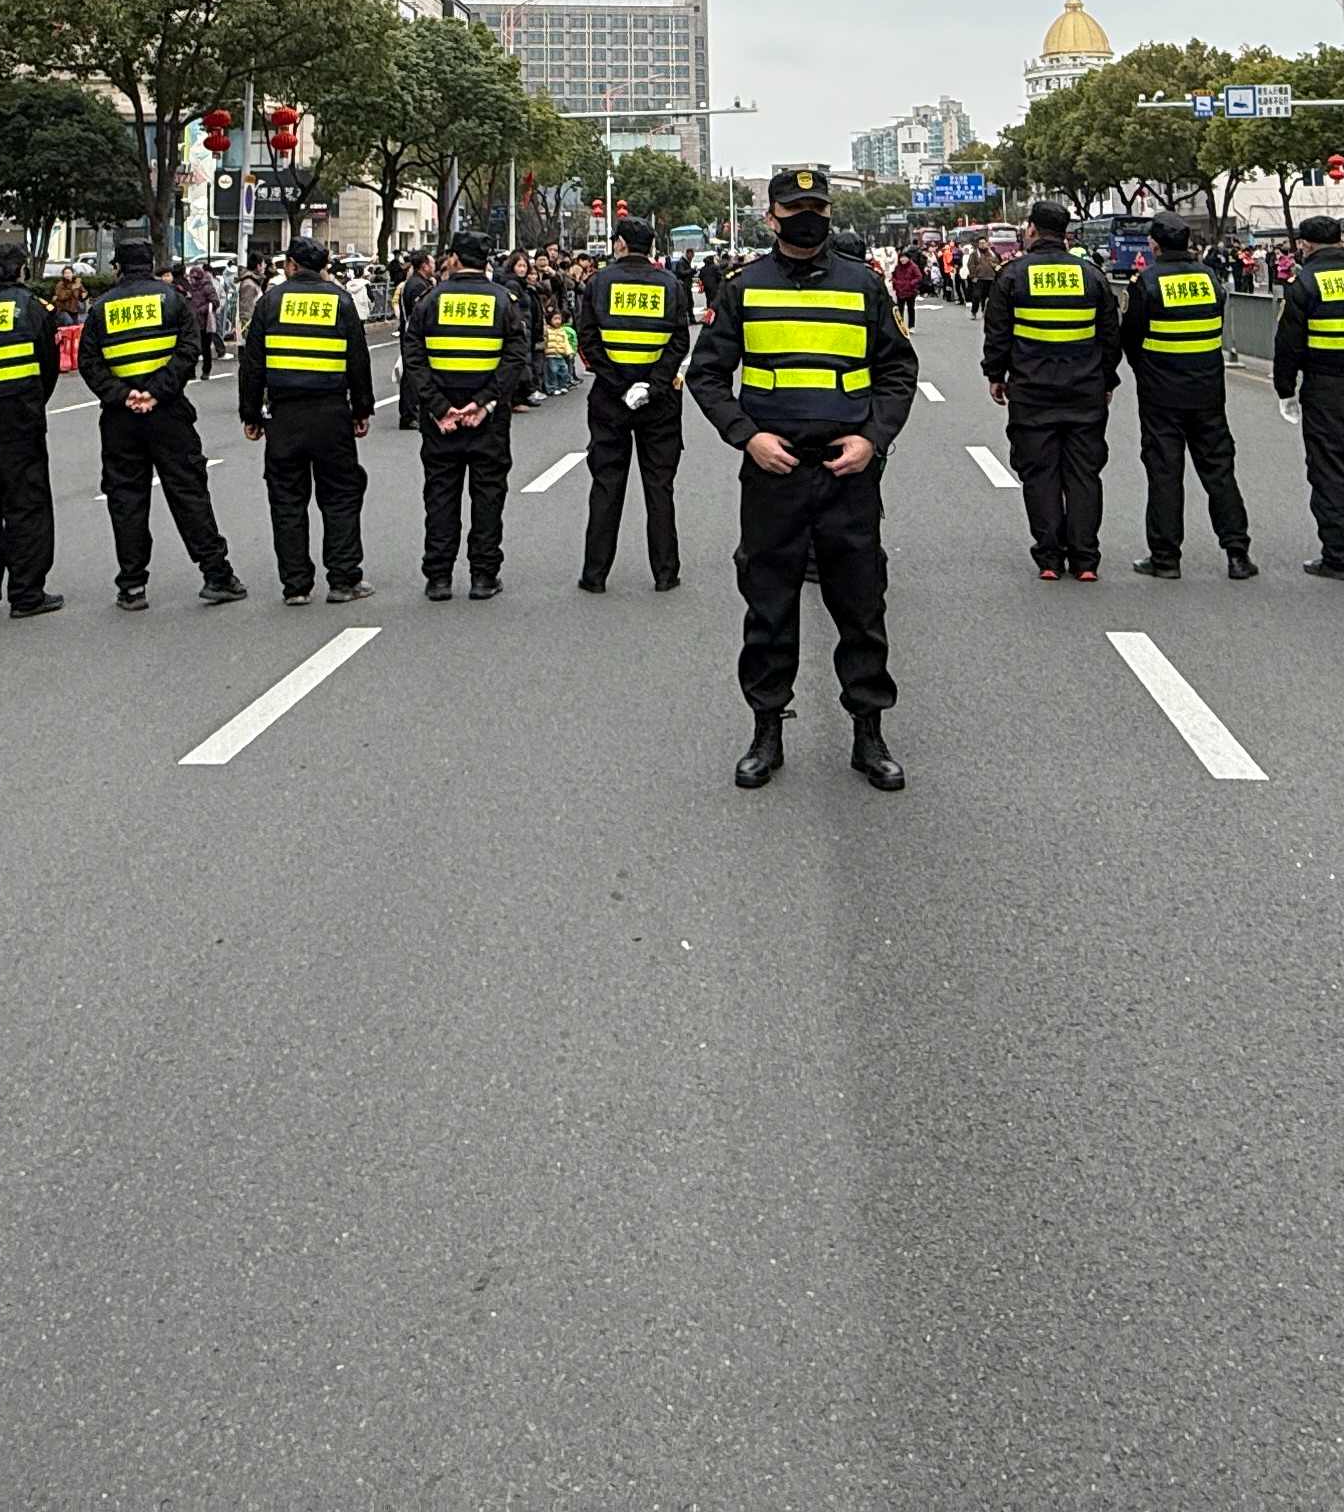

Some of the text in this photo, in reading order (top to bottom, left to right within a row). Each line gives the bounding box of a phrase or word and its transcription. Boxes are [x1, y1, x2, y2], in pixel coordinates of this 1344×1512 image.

[1034, 272, 1080, 289] 利邦保安
[1165, 282, 1211, 300] 利邦保安
[615, 292, 661, 311] 利邦保安
[109, 304, 157, 326] 利邦保安
[286, 302, 333, 319] 利邦保安
[443, 302, 490, 319] 利邦保安
